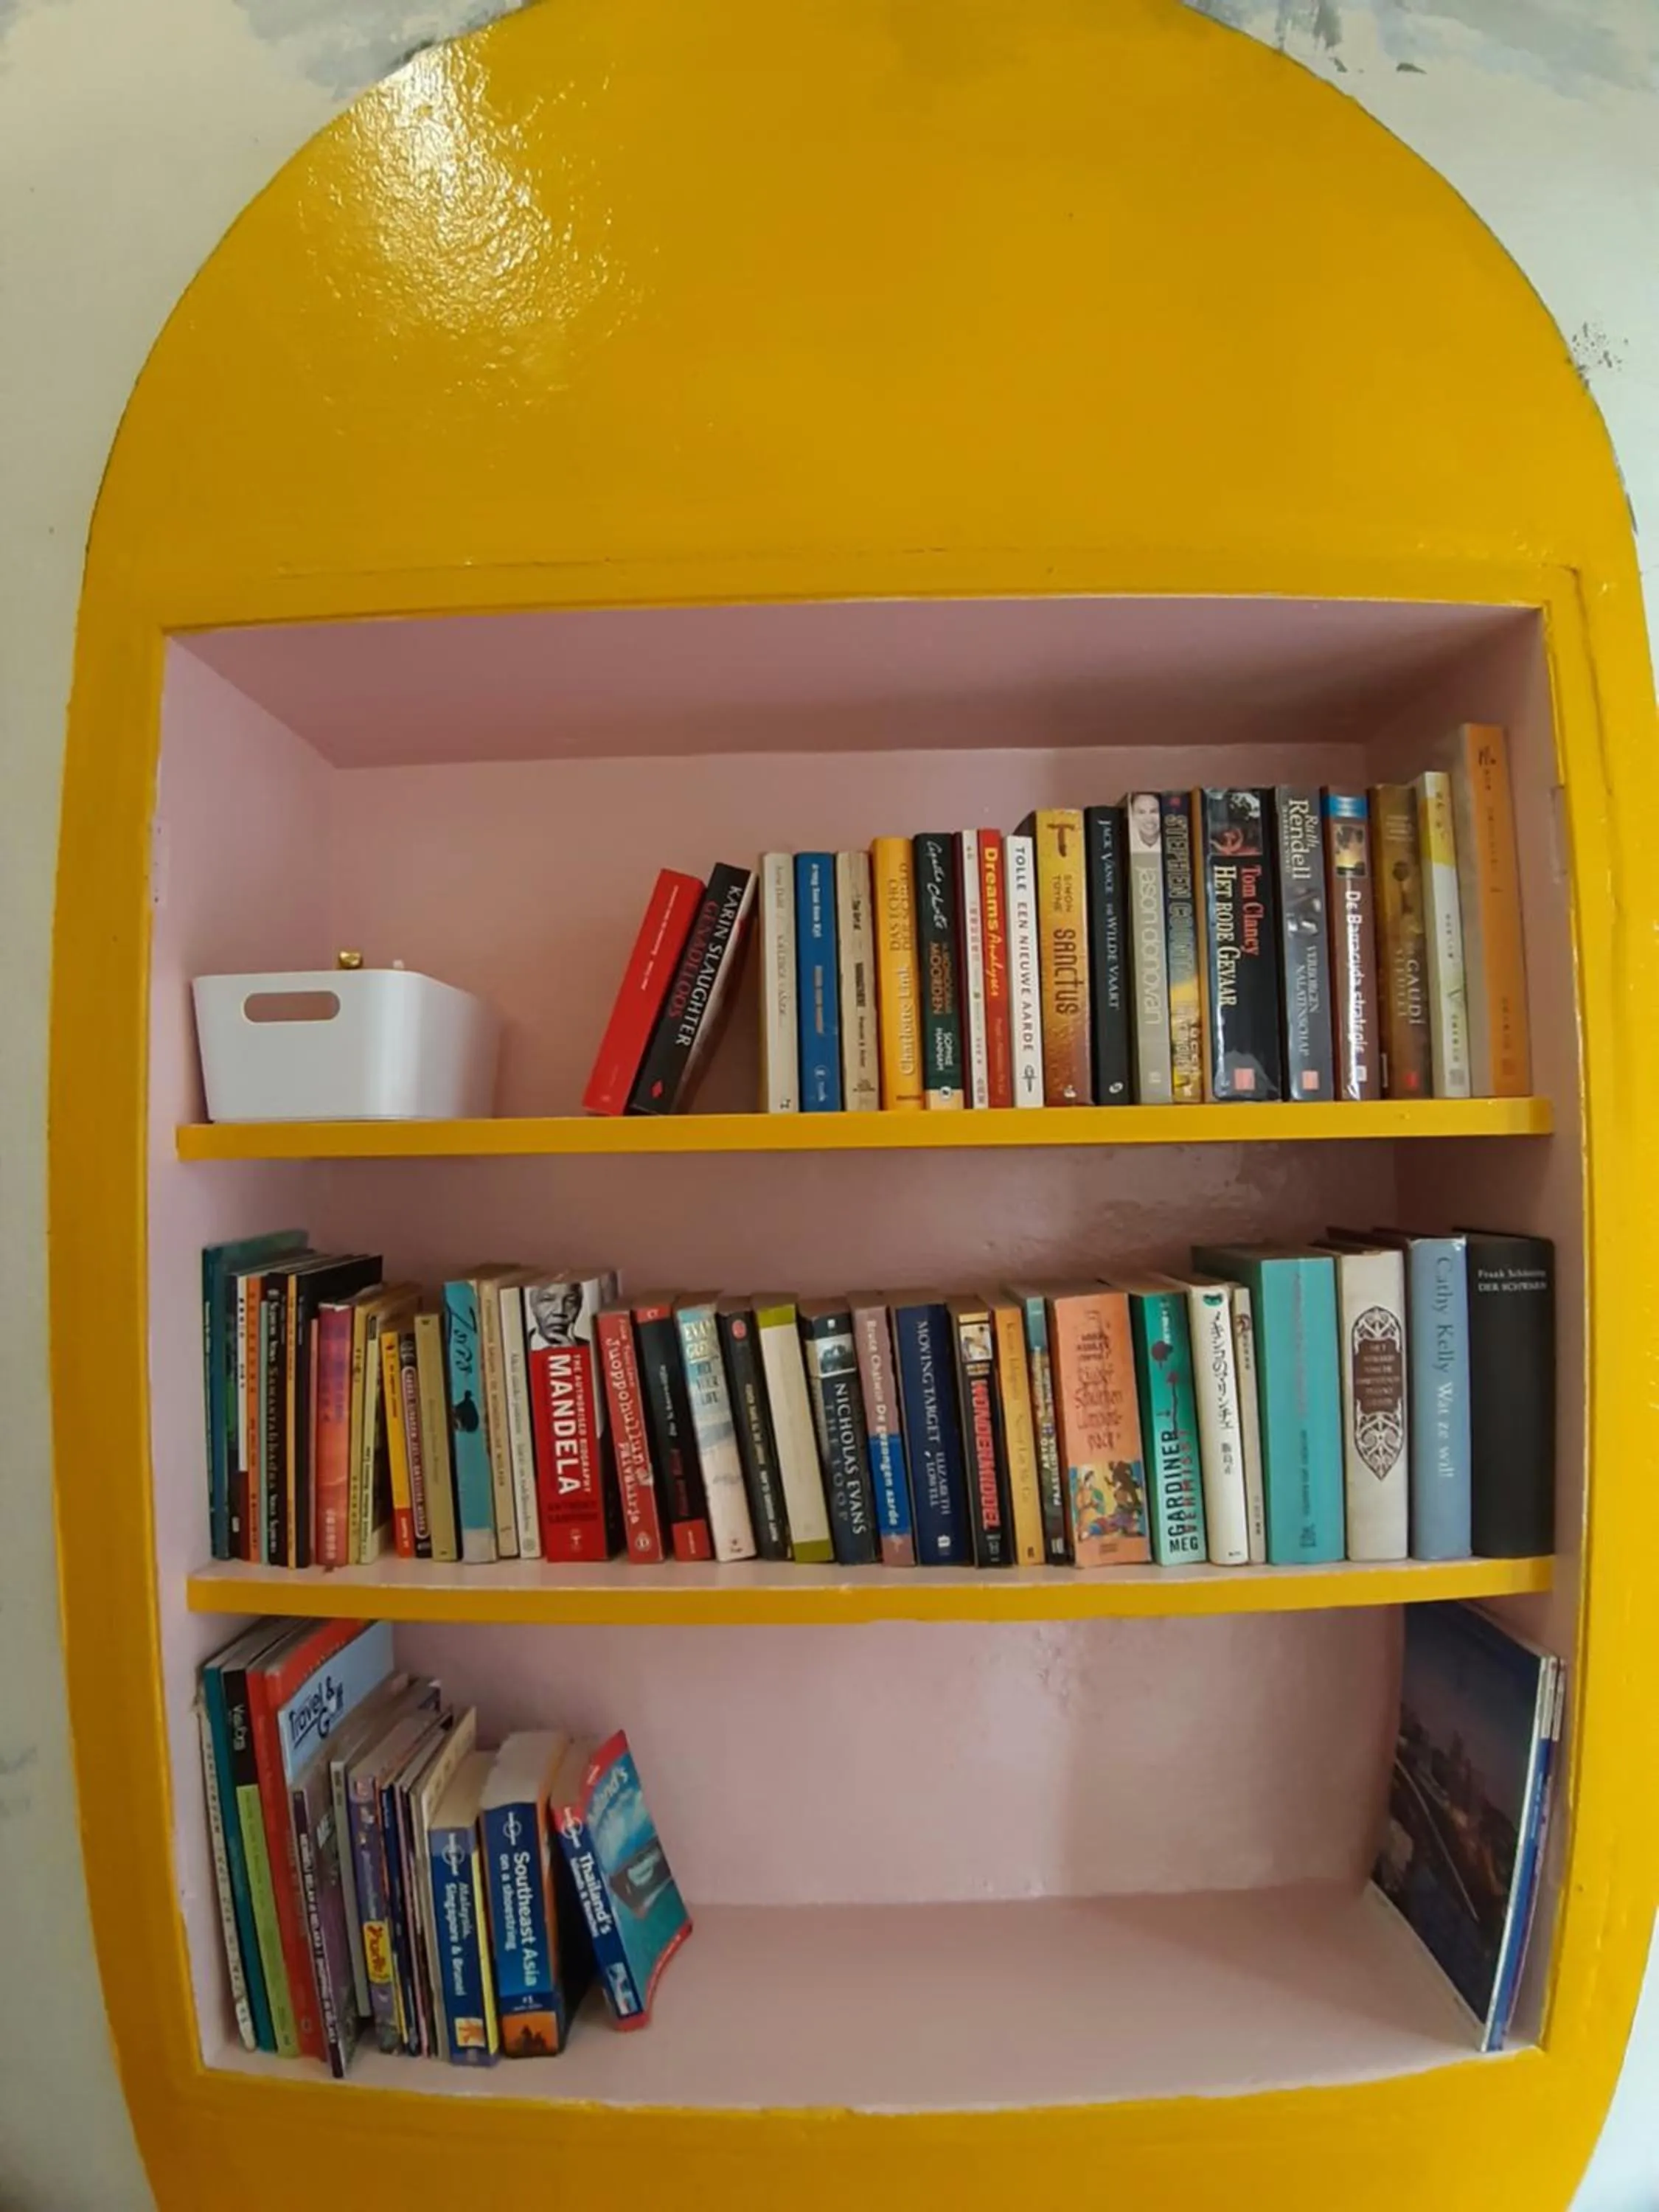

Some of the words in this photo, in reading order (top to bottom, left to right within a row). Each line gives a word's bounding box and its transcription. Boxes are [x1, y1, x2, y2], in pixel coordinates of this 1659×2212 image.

[1164, 813, 1192, 898] STEPHEN
[1289, 799, 1311, 880] Rendell
[1306, 814, 1321, 847] Ruth
[984, 846, 1000, 931] Dreams
[1015, 846, 1026, 891] TOLLE
[1053, 874, 1063, 912] TOYNE
[1063, 874, 1073, 913] SIMON
[1136, 867, 1158, 924] jason
[1242, 864, 1262, 898] Tom
[713, 886, 742, 939] KARIN
[1018, 902, 1027, 928] EEN
[1240, 902, 1265, 955] Clancy
[1345, 891, 1362, 909] De
[669, 900, 717, 1018] GENADELOOS
[1020, 935, 1031, 994] NIEUWE
[1107, 916, 1118, 961] WILDE
[1346, 914, 1365, 986] Barracuda
[675, 944, 723, 1047] SLAUGHTER
[930, 942, 943, 1015] MOORDEN
[1053, 928, 1084, 1015] SANCTUS
[1108, 965, 1120, 1009] VAART
[1141, 926, 1163, 1023] donovan
[1307, 945, 1321, 1013] VERBORGEN
[1407, 959, 1426, 1026] GAUDÍ
[1022, 1001, 1034, 1051] AARDE
[1295, 964, 1311, 1056] NALATENSCHAP
[898, 1004, 915, 1076] Charlotte
[934, 1028, 945, 1071] HANNAH
[944, 1032, 953, 1065] SOPHIE
[1432, 1256, 1453, 1315] Cathy
[573, 1353, 582, 1371] THE
[866, 1319, 879, 1352] Bruce
[916, 1320, 934, 1384] MOVING
[1433, 1323, 1455, 1374] Kelly
[575, 1374, 586, 1436] AUTHORISED
[606, 1337, 644, 1470] Juoppohullun
[870, 1354, 883, 1402] Chatwin
[1436, 1382, 1453, 1416] Wat
[549, 1354, 580, 1495] MANDELA
[877, 1404, 887, 1421] De
[923, 1386, 942, 1444] TARGET
[1438, 1421, 1451, 1439] ze
[580, 1439, 591, 1493] BIOGRAPHY
[834, 1382, 858, 1475] NICHOLAS
[846, 1481, 866, 1535] EVANS
[873, 1425, 894, 1486] gezongen
[936, 1451, 950, 1515] ELIZABETH
[970, 1379, 1001, 1531] WONDERMIDDEL
[1161, 1429, 1187, 1538] GARDINER
[885, 1489, 899, 1526] aarde
[925, 1462, 939, 1507] LOWELL
[1169, 1537, 1199, 1554] MEG
[500, 1854, 510, 1871] on
[445, 1882, 458, 1942] Singapore
[503, 1883, 518, 1951] shoestring
[513, 1851, 536, 1944] Southeast
[579, 1850, 612, 1936] Thailand's
[451, 1944, 459, 1955] &
[452, 1958, 465, 1996] Brunei
[524, 1947, 540, 1986] Asia
